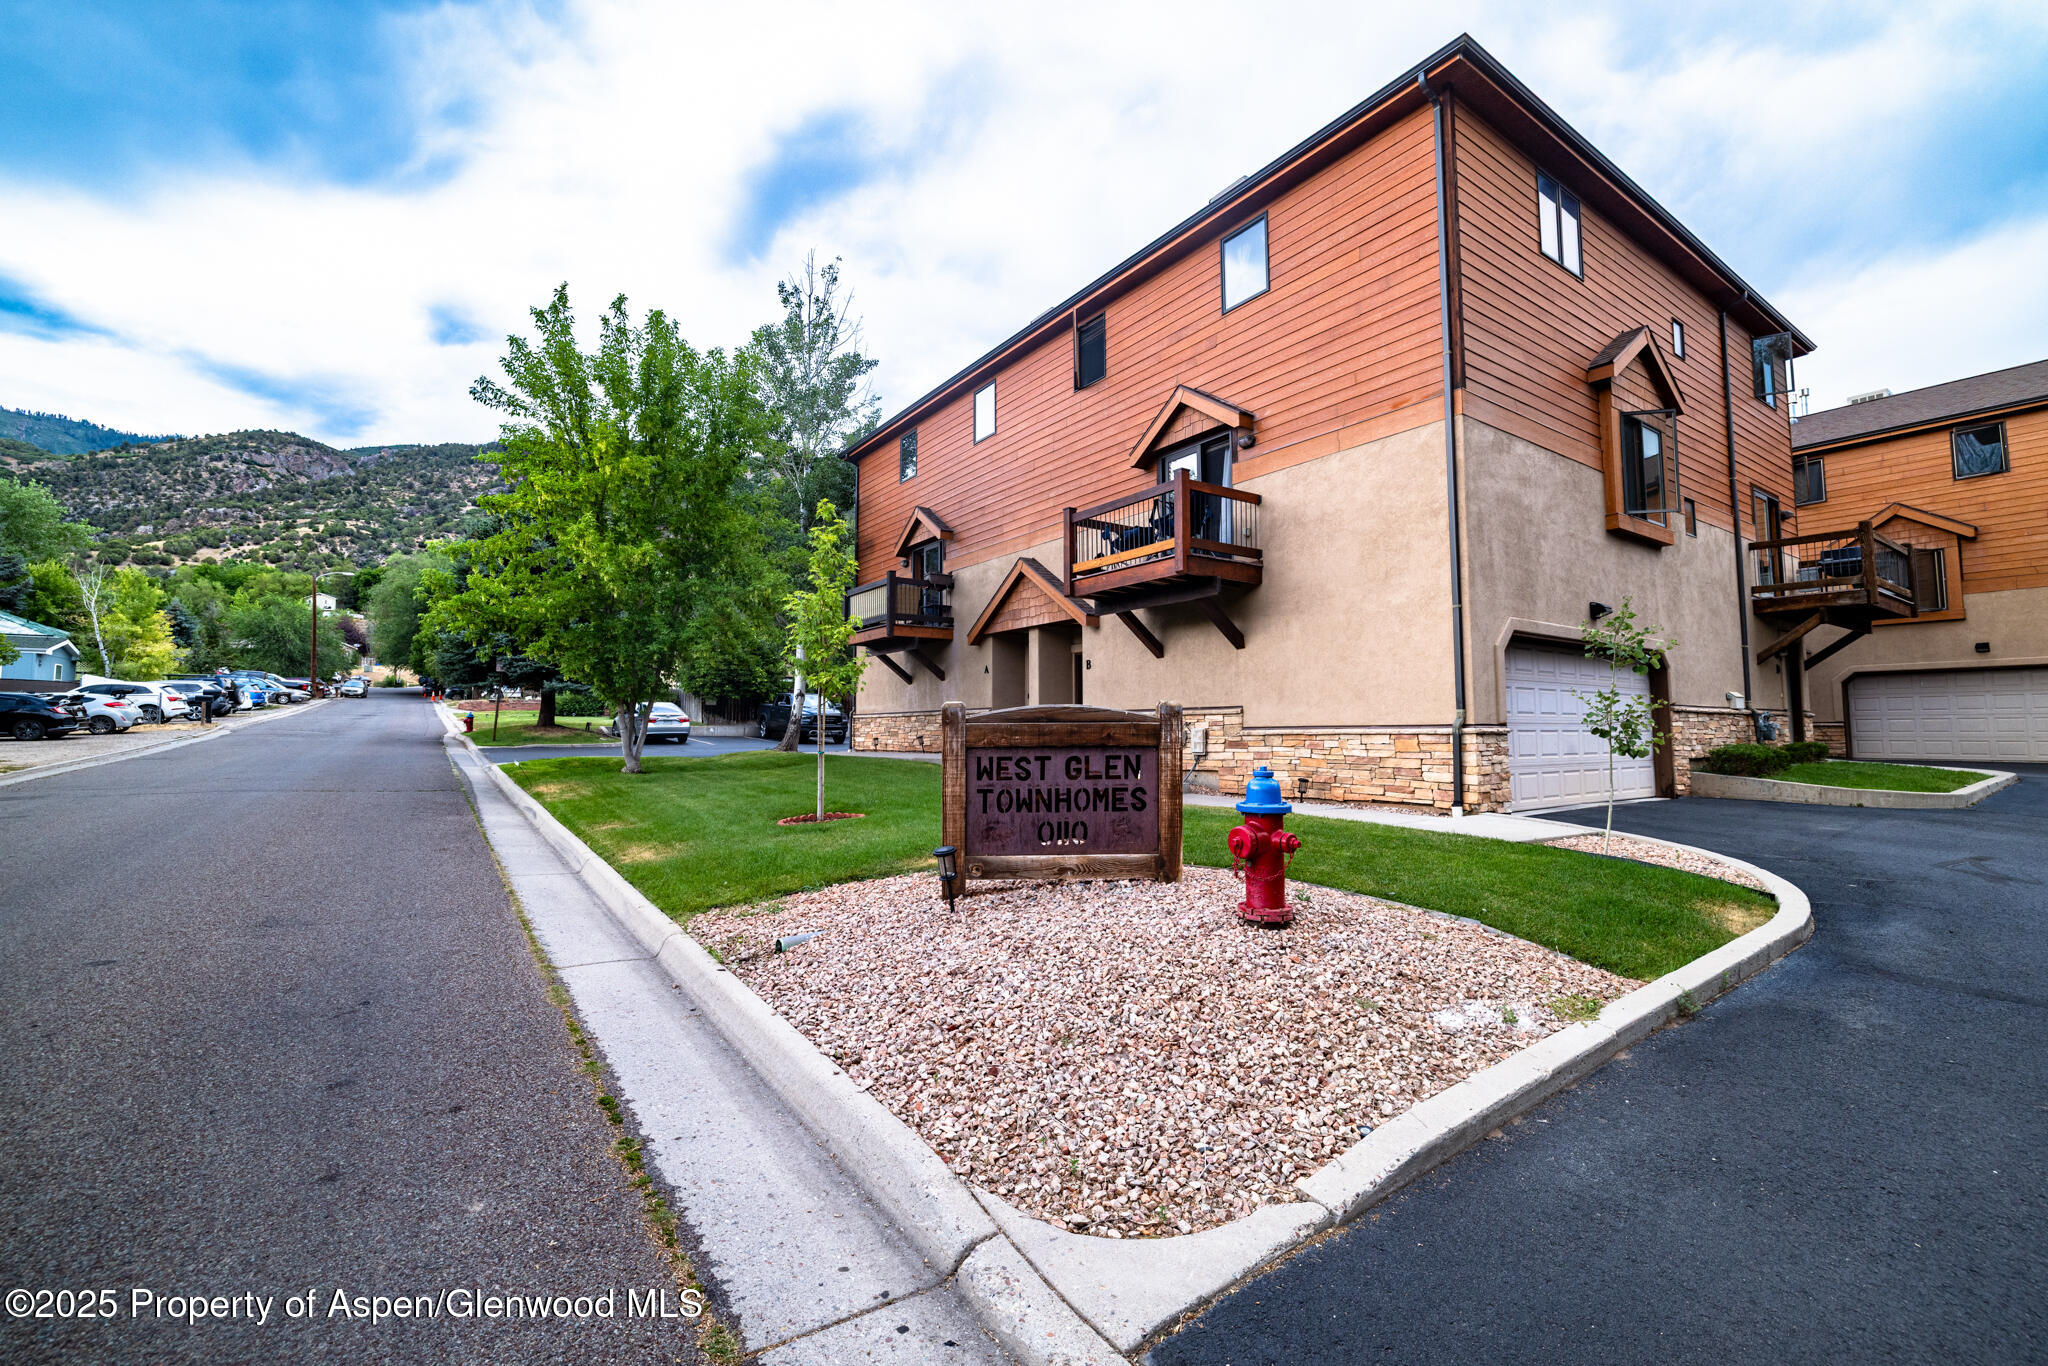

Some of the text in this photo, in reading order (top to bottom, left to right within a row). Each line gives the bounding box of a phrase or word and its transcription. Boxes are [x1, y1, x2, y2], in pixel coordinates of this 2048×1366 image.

[984, 665, 990, 674] A
[1086, 660, 1092, 670] B
[976, 754, 1142, 781] WEST GLEN
[976, 786, 1148, 814] TOWNHOMES
